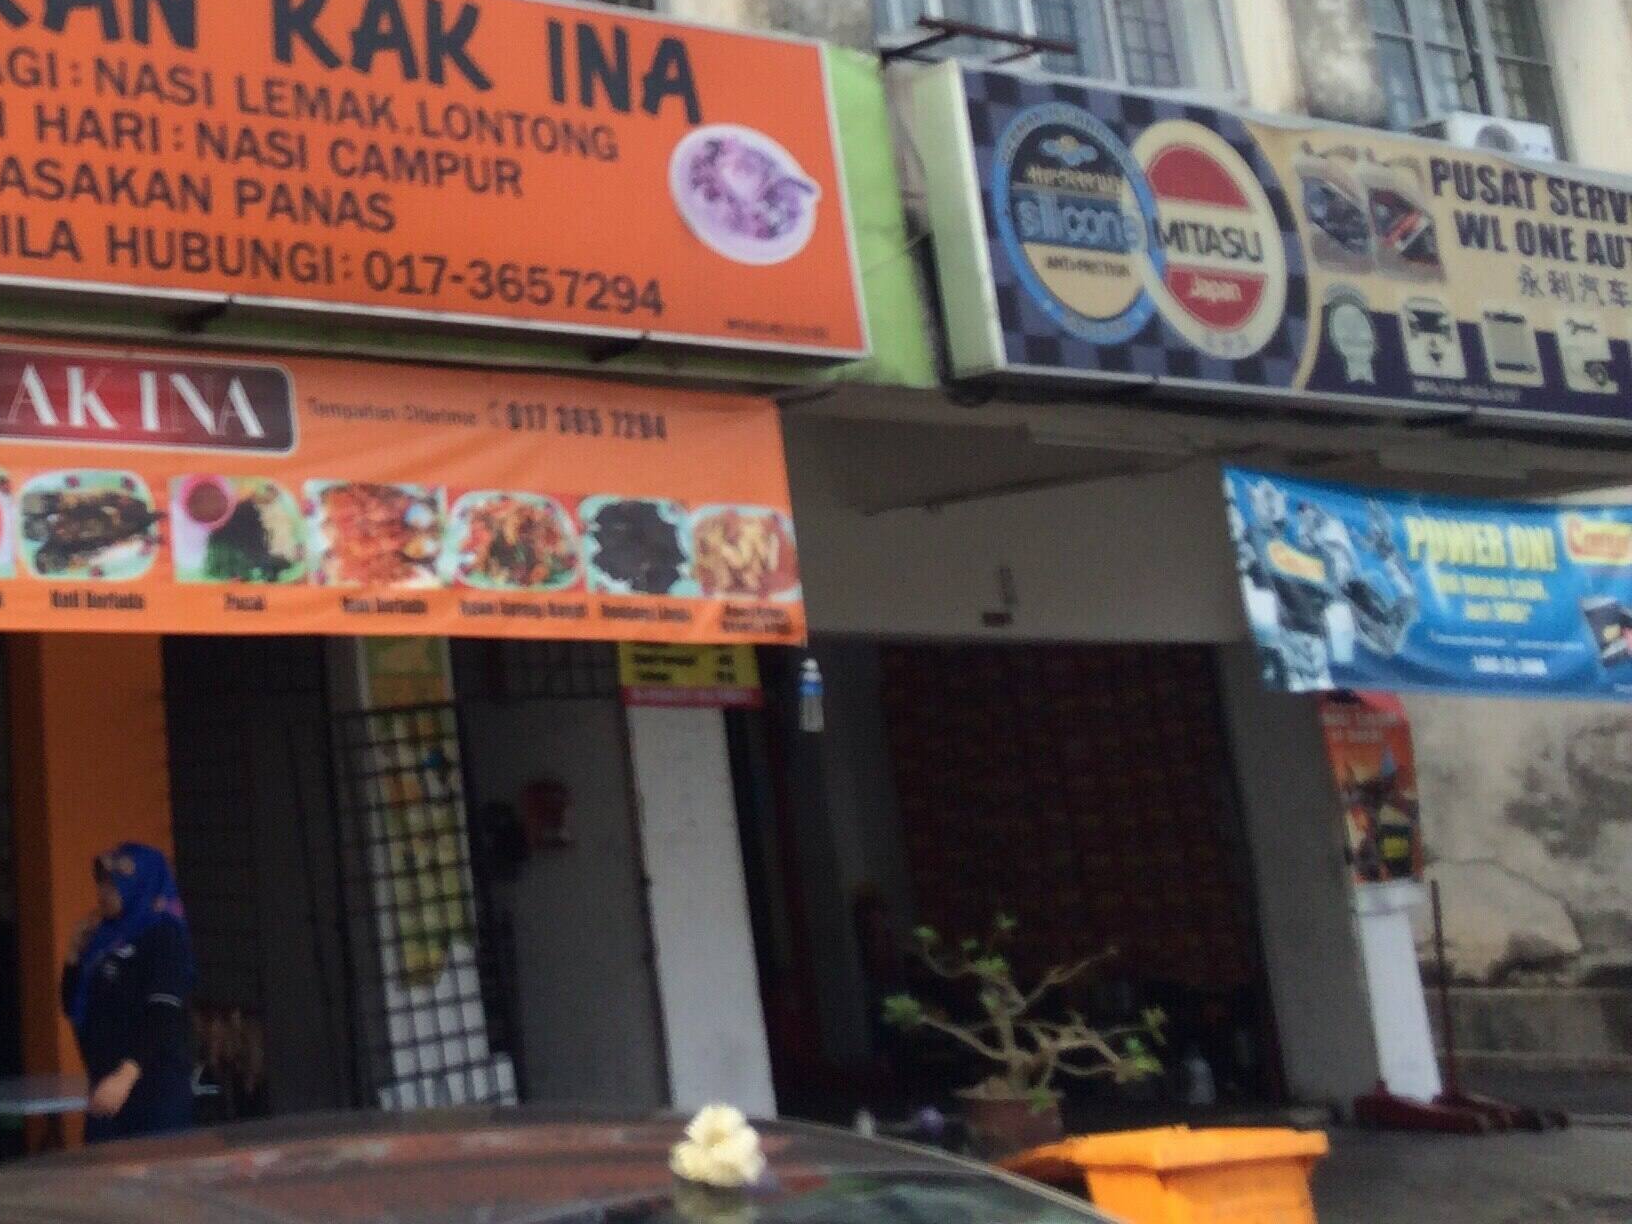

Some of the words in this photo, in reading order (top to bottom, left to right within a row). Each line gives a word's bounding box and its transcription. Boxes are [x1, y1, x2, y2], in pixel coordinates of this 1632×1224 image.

[546, 17, 704, 128] INA
[328, 137, 523, 196] CAMPUR
[1429, 155, 1537, 211] PUSAT
[1547, 174, 1632, 225] SERV
[233, 176, 397, 234] PANAS
[1157, 219, 1265, 264] MITASU
[1453, 208, 1508, 253] WL
[1515, 219, 1579, 263] ONE
[137, 369, 265, 439] INA
